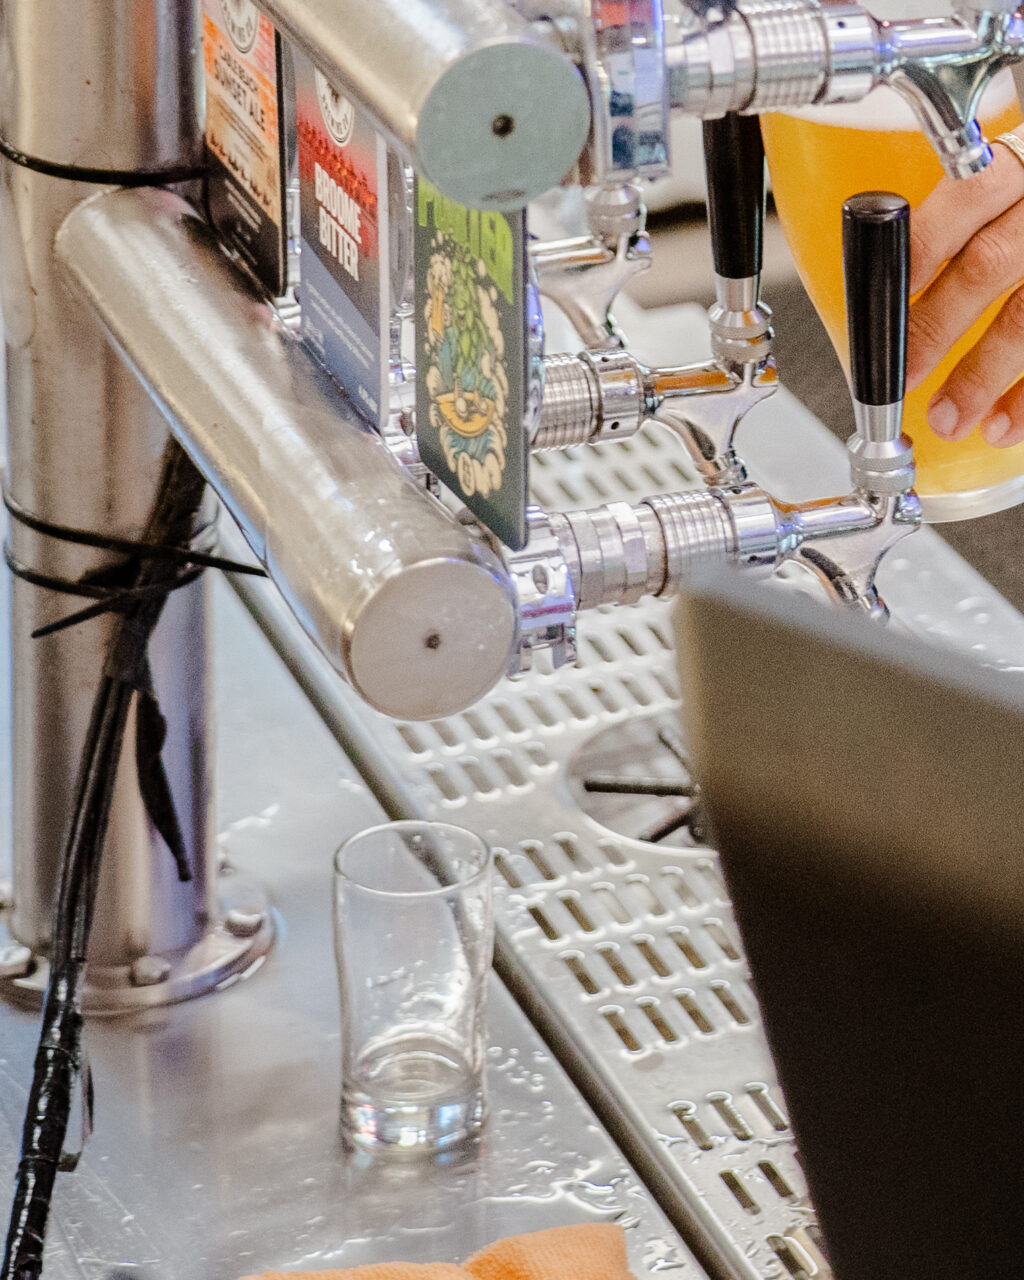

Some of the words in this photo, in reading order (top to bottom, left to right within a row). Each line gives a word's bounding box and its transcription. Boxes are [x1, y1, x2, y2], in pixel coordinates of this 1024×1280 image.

[249, 97, 266, 133] ALE
[314, 161, 362, 245] BROOME
[319, 204, 360, 282] BITTER
